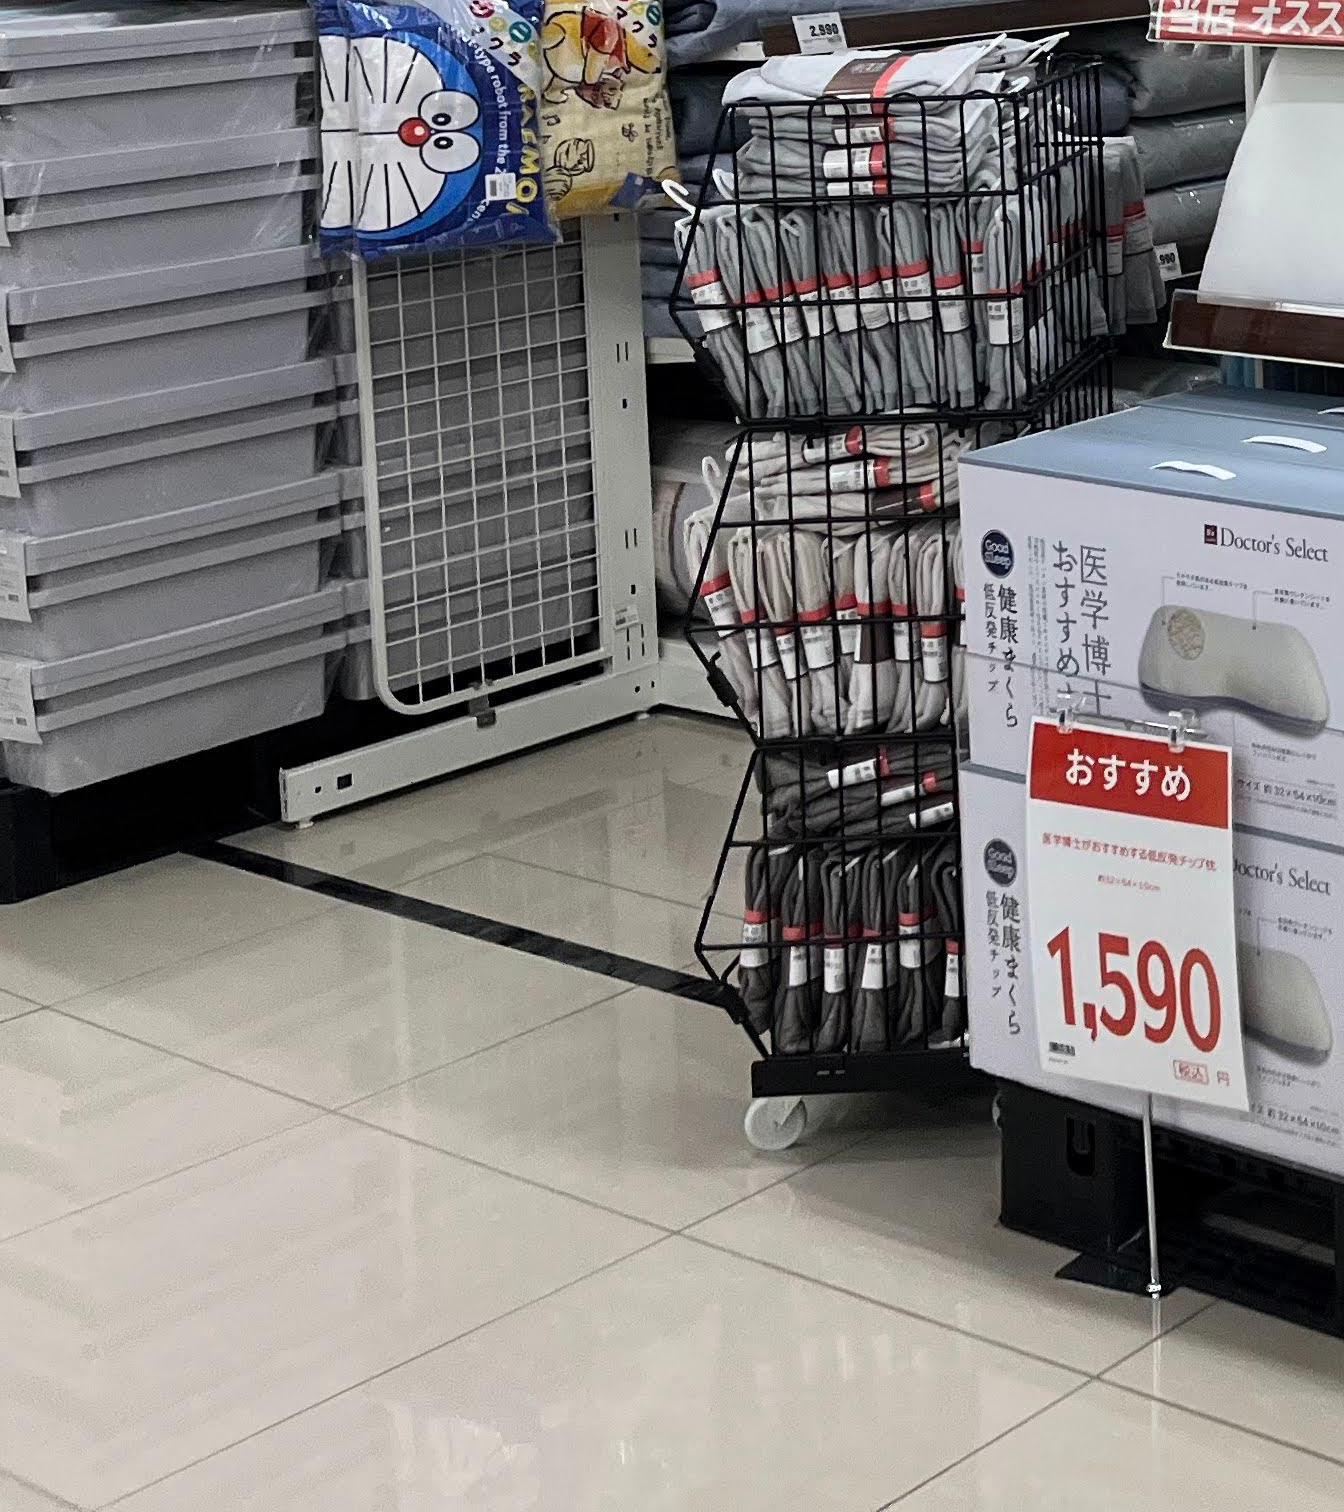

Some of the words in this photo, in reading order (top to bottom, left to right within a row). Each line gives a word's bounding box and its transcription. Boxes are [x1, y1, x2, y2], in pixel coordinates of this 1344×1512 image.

[490, 74, 507, 109] robot
[496, 110, 512, 148] from
[495, 146, 508, 166] the
[985, 539, 1009, 554] Good
[1220, 526, 1280, 555] Doctor's
[1285, 537, 1329, 562] Select
[983, 582, 999, 693] 低反発チップ
[998, 583, 1019, 729] 健康まくら
[1064, 748, 1192, 802] おすすめ
[1041, 831, 1218, 873] 医学博士がおすすめする低反発チップ枕
[1288, 866, 1332, 897] Select
[1001, 892, 1021, 1036] 健康まくら
[1046, 925, 1223, 1053] 1,590
[1216, 1070, 1230, 1087] 円
